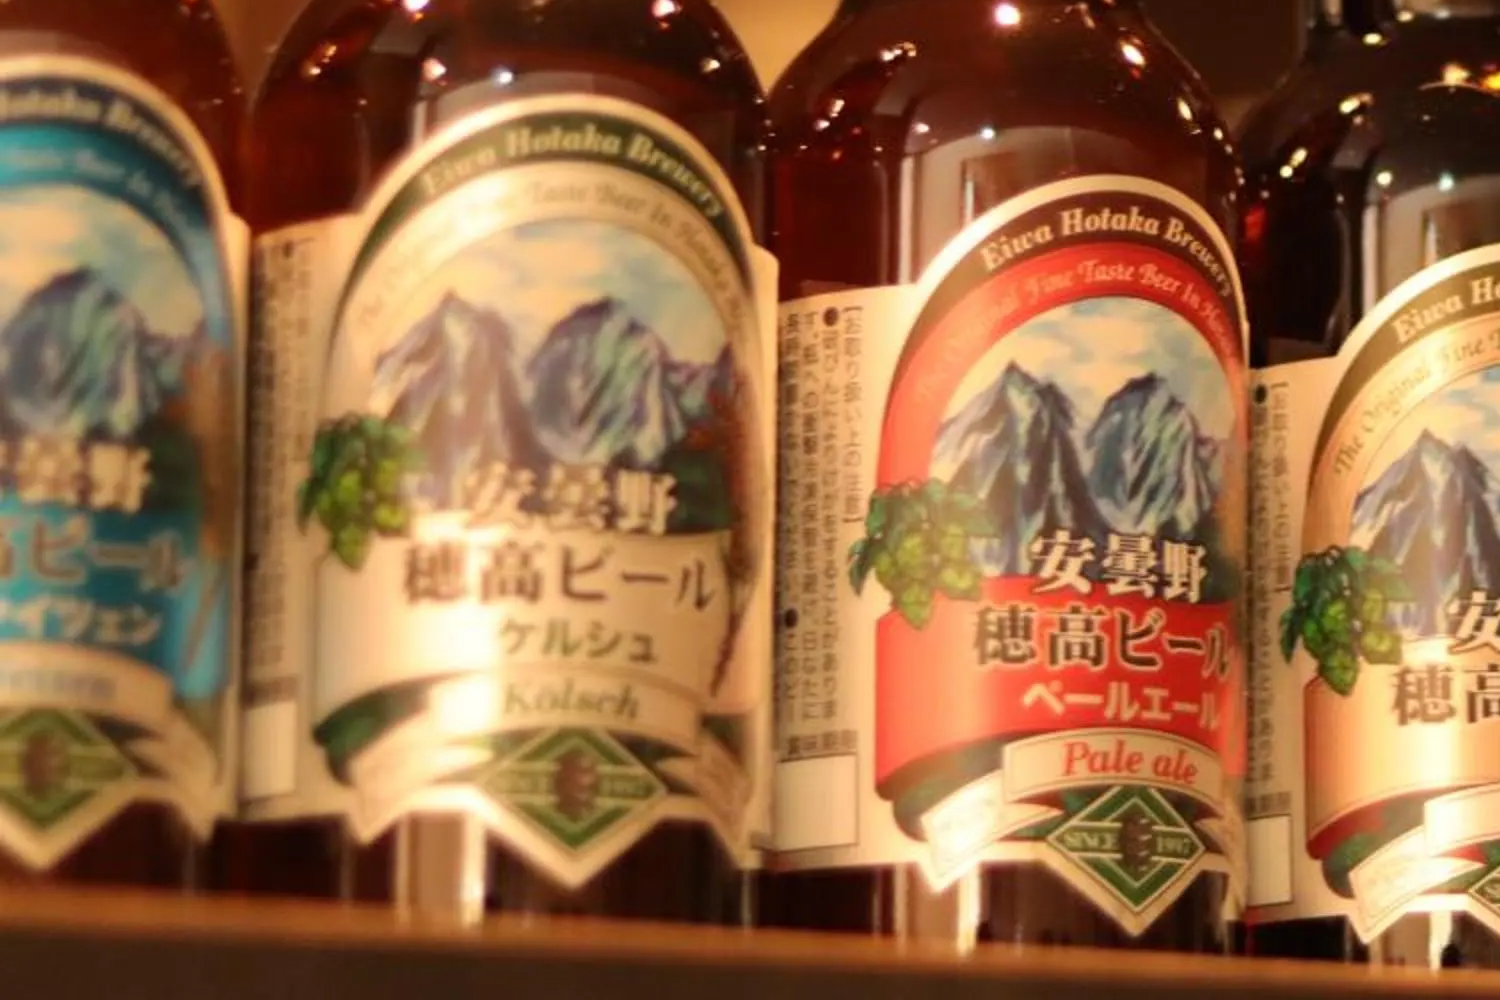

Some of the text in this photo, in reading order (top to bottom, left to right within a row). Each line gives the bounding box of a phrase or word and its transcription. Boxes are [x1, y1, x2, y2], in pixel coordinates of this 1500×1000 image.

[506, 123, 622, 157] Hotaka
[626, 132, 723, 216] Brewery
[979, 206, 1231, 297] Eiwa Hotaka Brewery
[1077, 259, 1135, 283] Taste
[1138, 262, 1182, 293] Beer
[1391, 292, 1463, 342] Eiwa
[1333, 435, 1364, 476] The
[402, 541, 716, 612] 穂高ビール
[1031, 528, 1208, 603] 安曇野
[500, 617, 658, 664] ケルシュ
[973, 602, 1235, 685] 穂高ビール
[1022, 680, 1221, 730] ペールエール
[1062, 739, 1200, 785] Pale ale
[1063, 831, 1117, 851] SINCE
